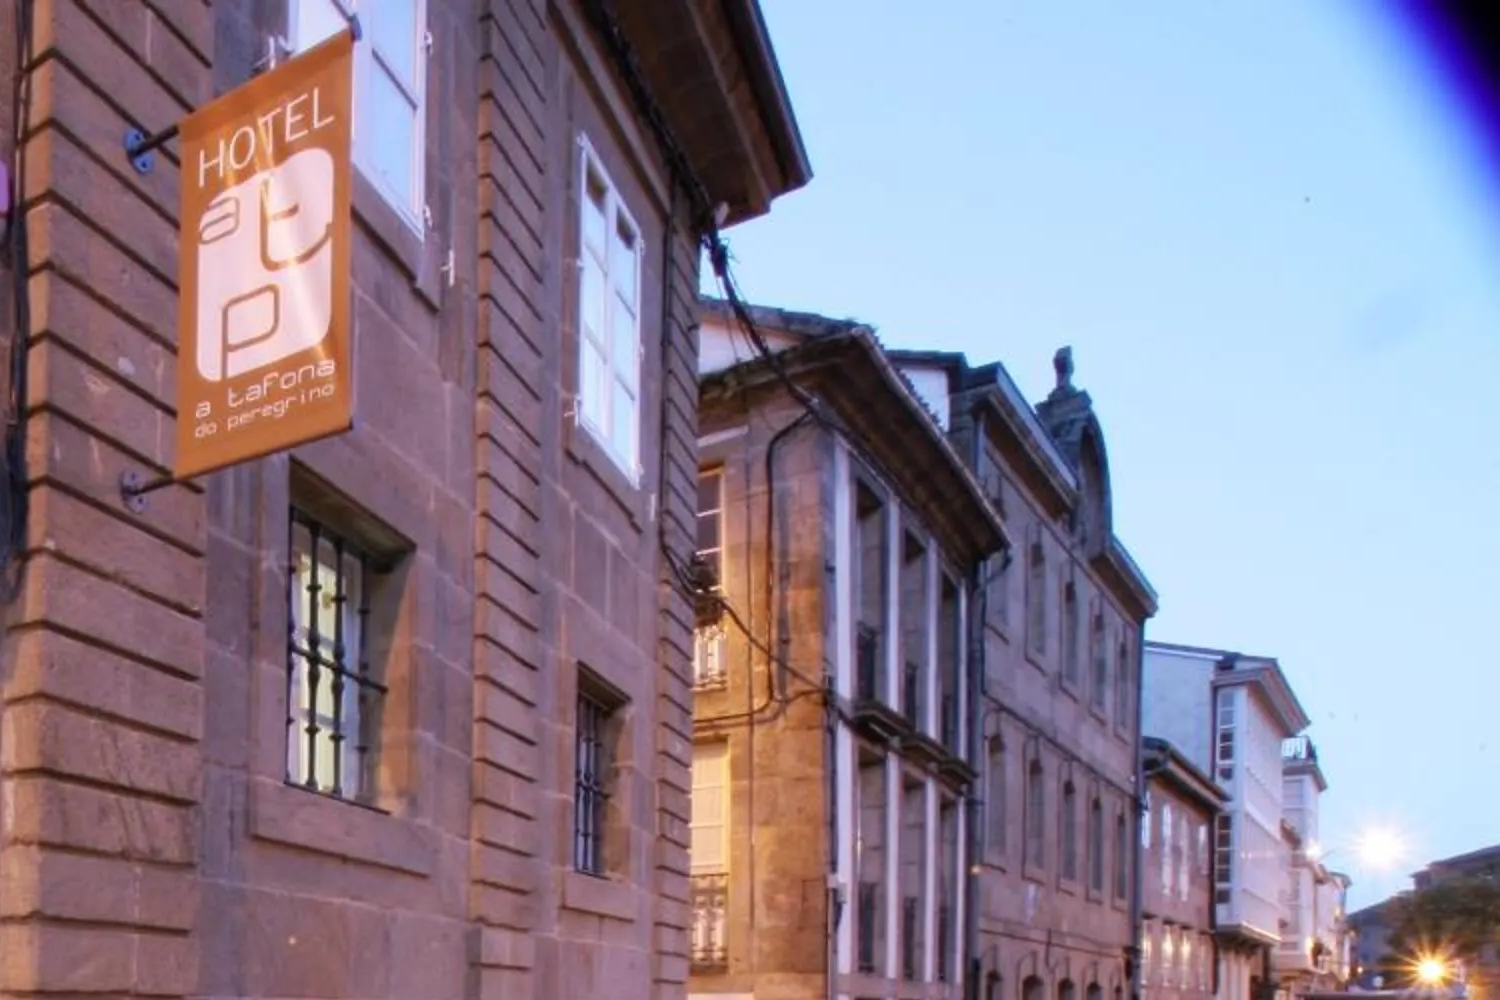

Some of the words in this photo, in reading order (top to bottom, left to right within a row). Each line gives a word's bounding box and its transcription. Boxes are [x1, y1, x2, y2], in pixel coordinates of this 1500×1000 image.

[198, 87, 335, 188] HOTEL
[195, 400, 211, 418] a
[195, 421, 217, 438] do
[227, 383, 336, 432] peregrino
